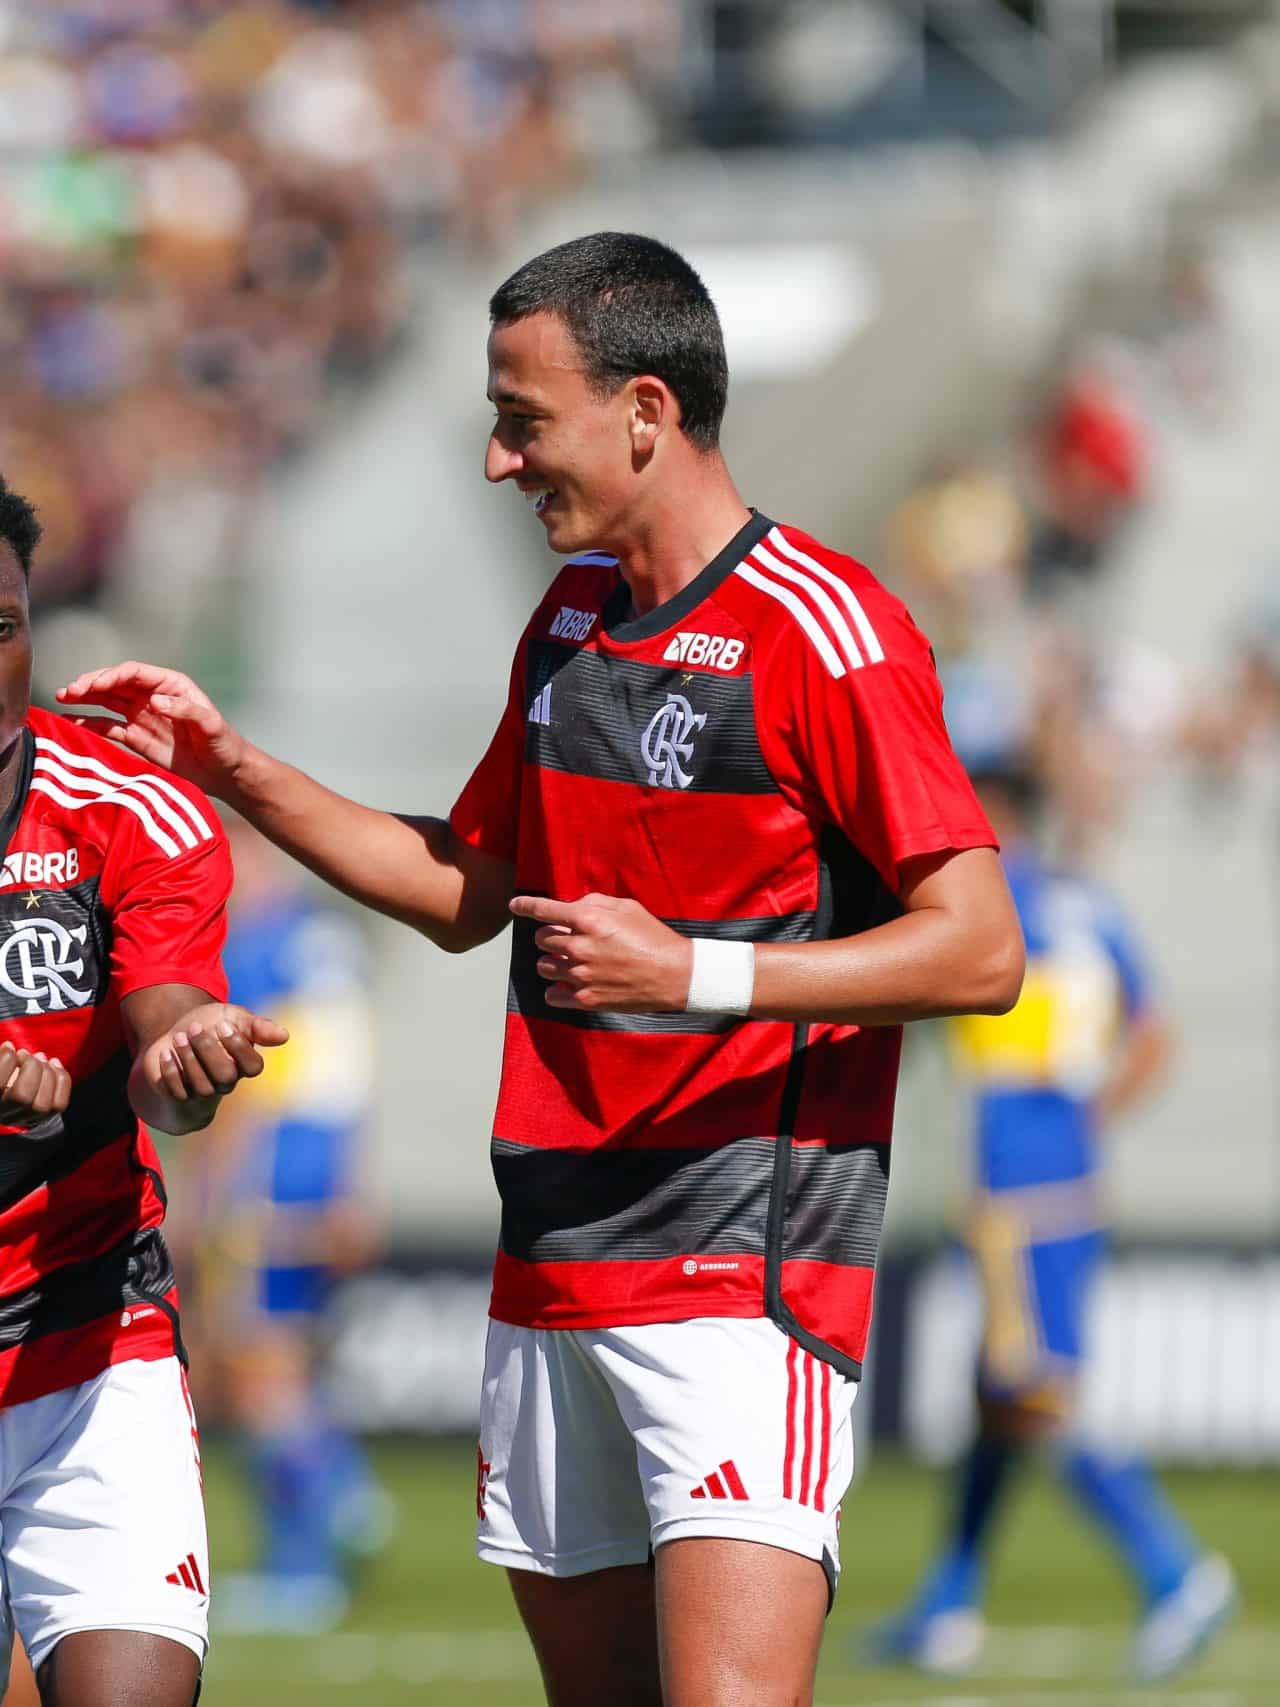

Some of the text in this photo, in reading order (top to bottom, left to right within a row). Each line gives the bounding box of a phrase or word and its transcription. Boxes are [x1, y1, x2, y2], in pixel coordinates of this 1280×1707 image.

[560, 610, 597, 640] BRB
[688, 635, 744, 670] BRB
[24, 848, 79, 884] BRB
